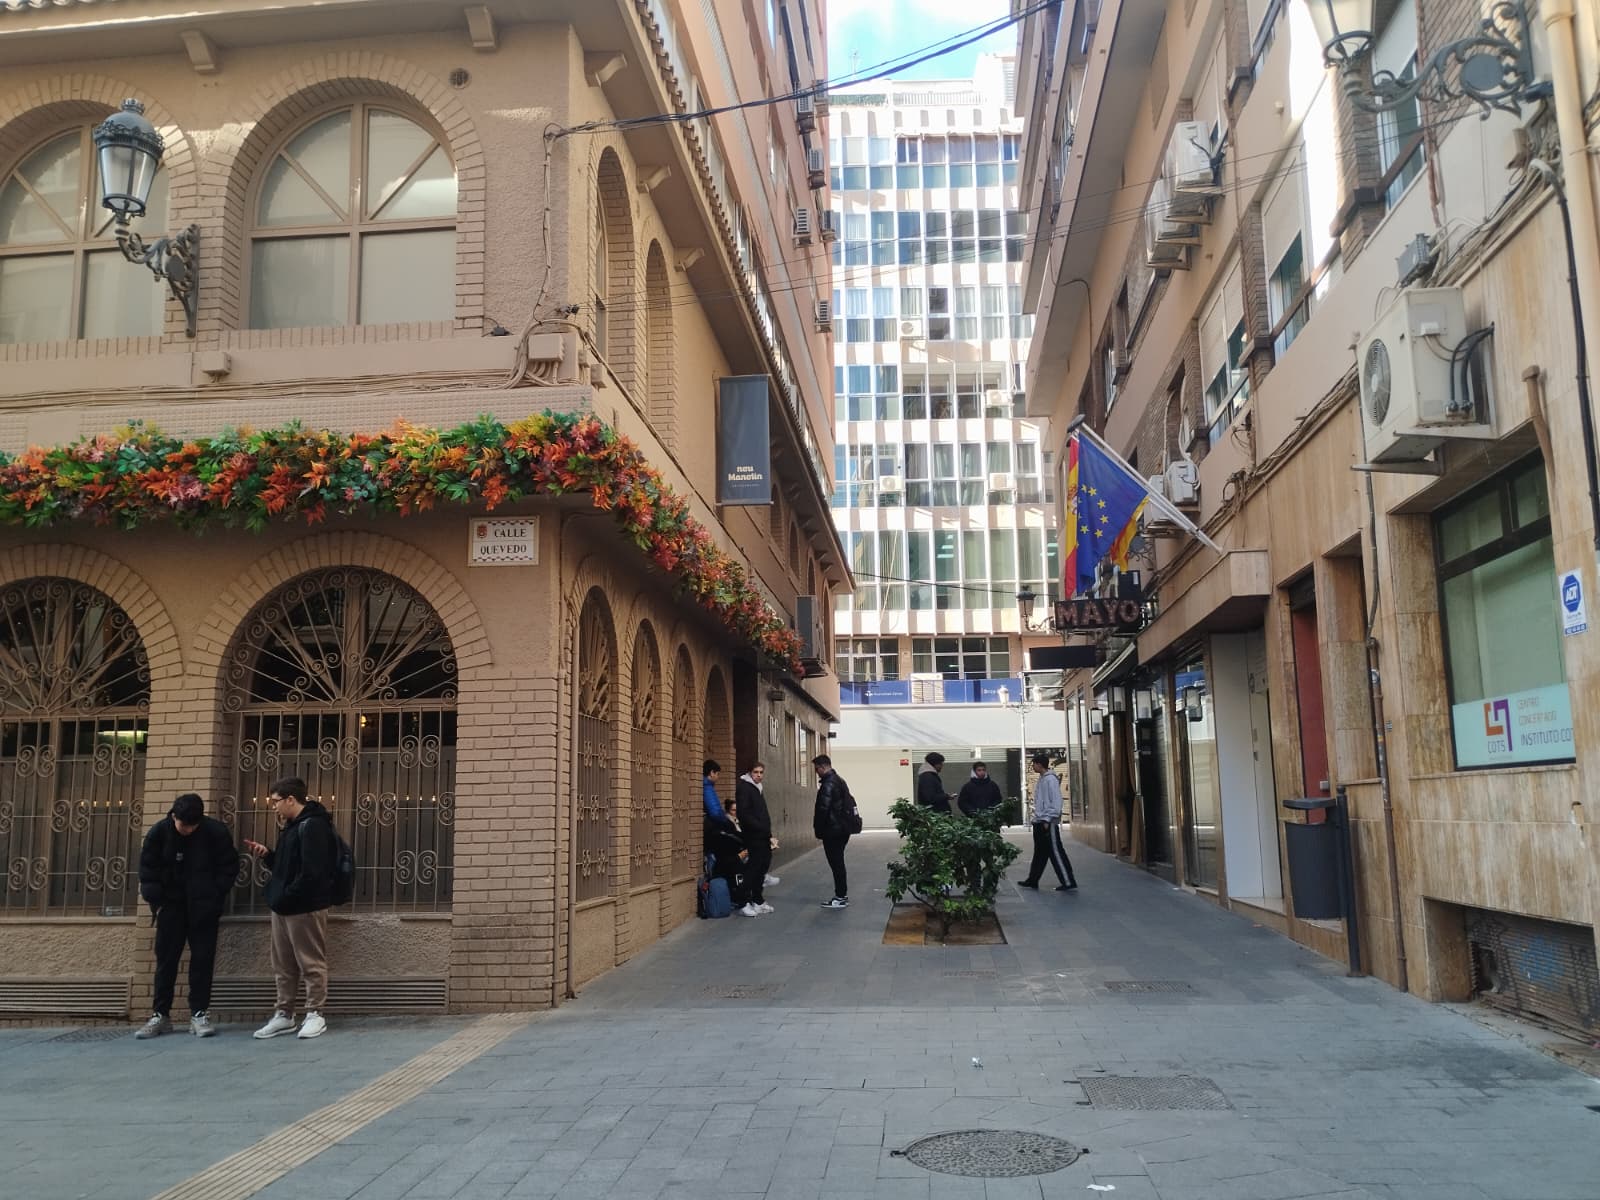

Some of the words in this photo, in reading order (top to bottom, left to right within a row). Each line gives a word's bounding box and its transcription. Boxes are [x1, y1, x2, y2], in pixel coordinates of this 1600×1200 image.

[494, 528, 527, 538] CALLE
[480, 544, 527, 555] QUEVEDO
[1057, 600, 1140, 627] MAYO
[1520, 729, 1560, 747] INSTITUTO
[1487, 740, 1506, 754] COTS
